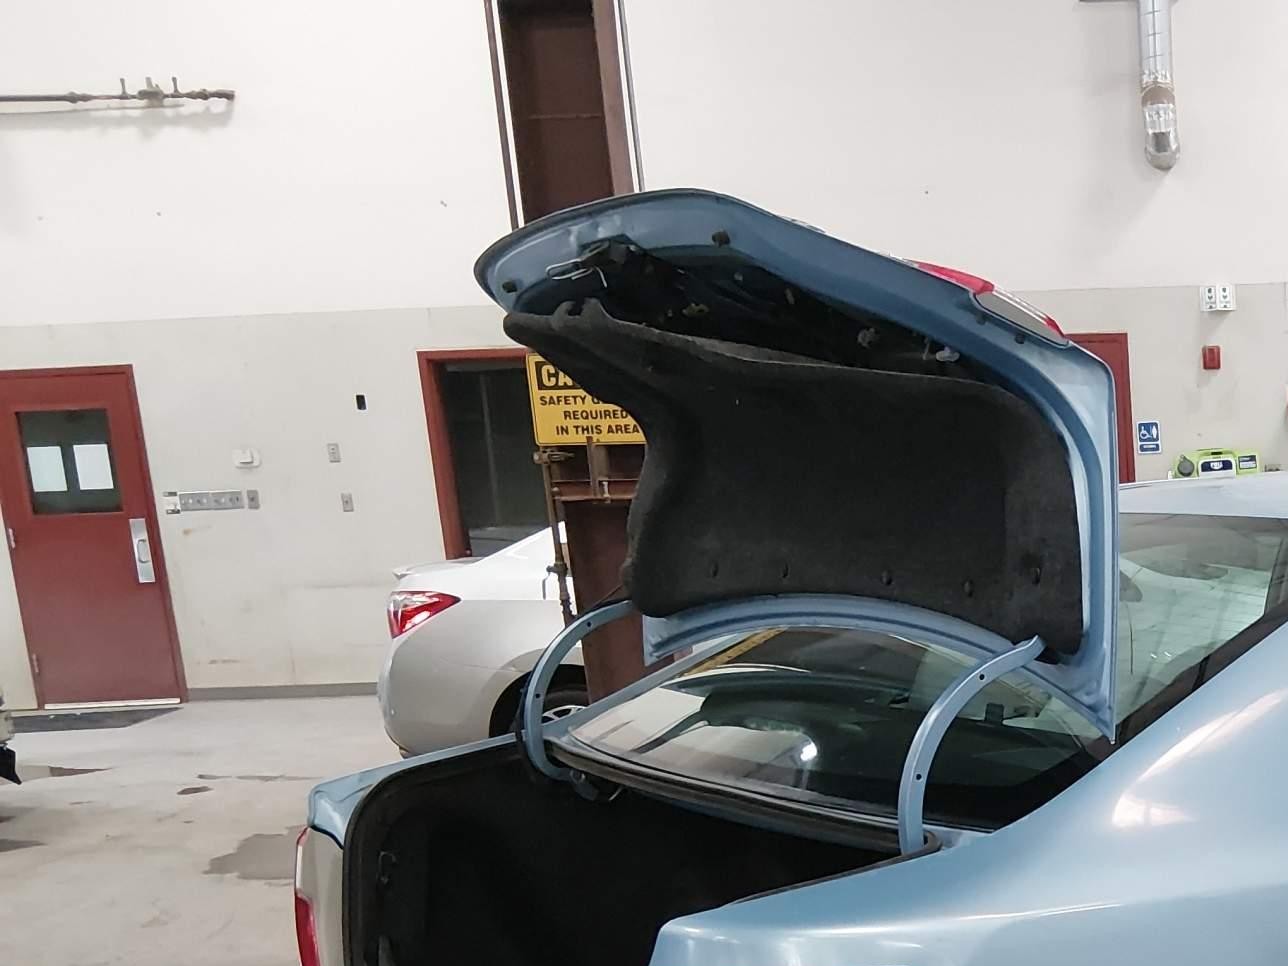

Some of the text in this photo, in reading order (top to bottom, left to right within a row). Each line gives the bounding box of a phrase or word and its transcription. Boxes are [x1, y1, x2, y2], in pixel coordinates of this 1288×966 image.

[540, 395, 586, 405] SAFETY
[563, 409, 629, 420] REQUIRED
[556, 423, 640, 435] IN THIS AREA
